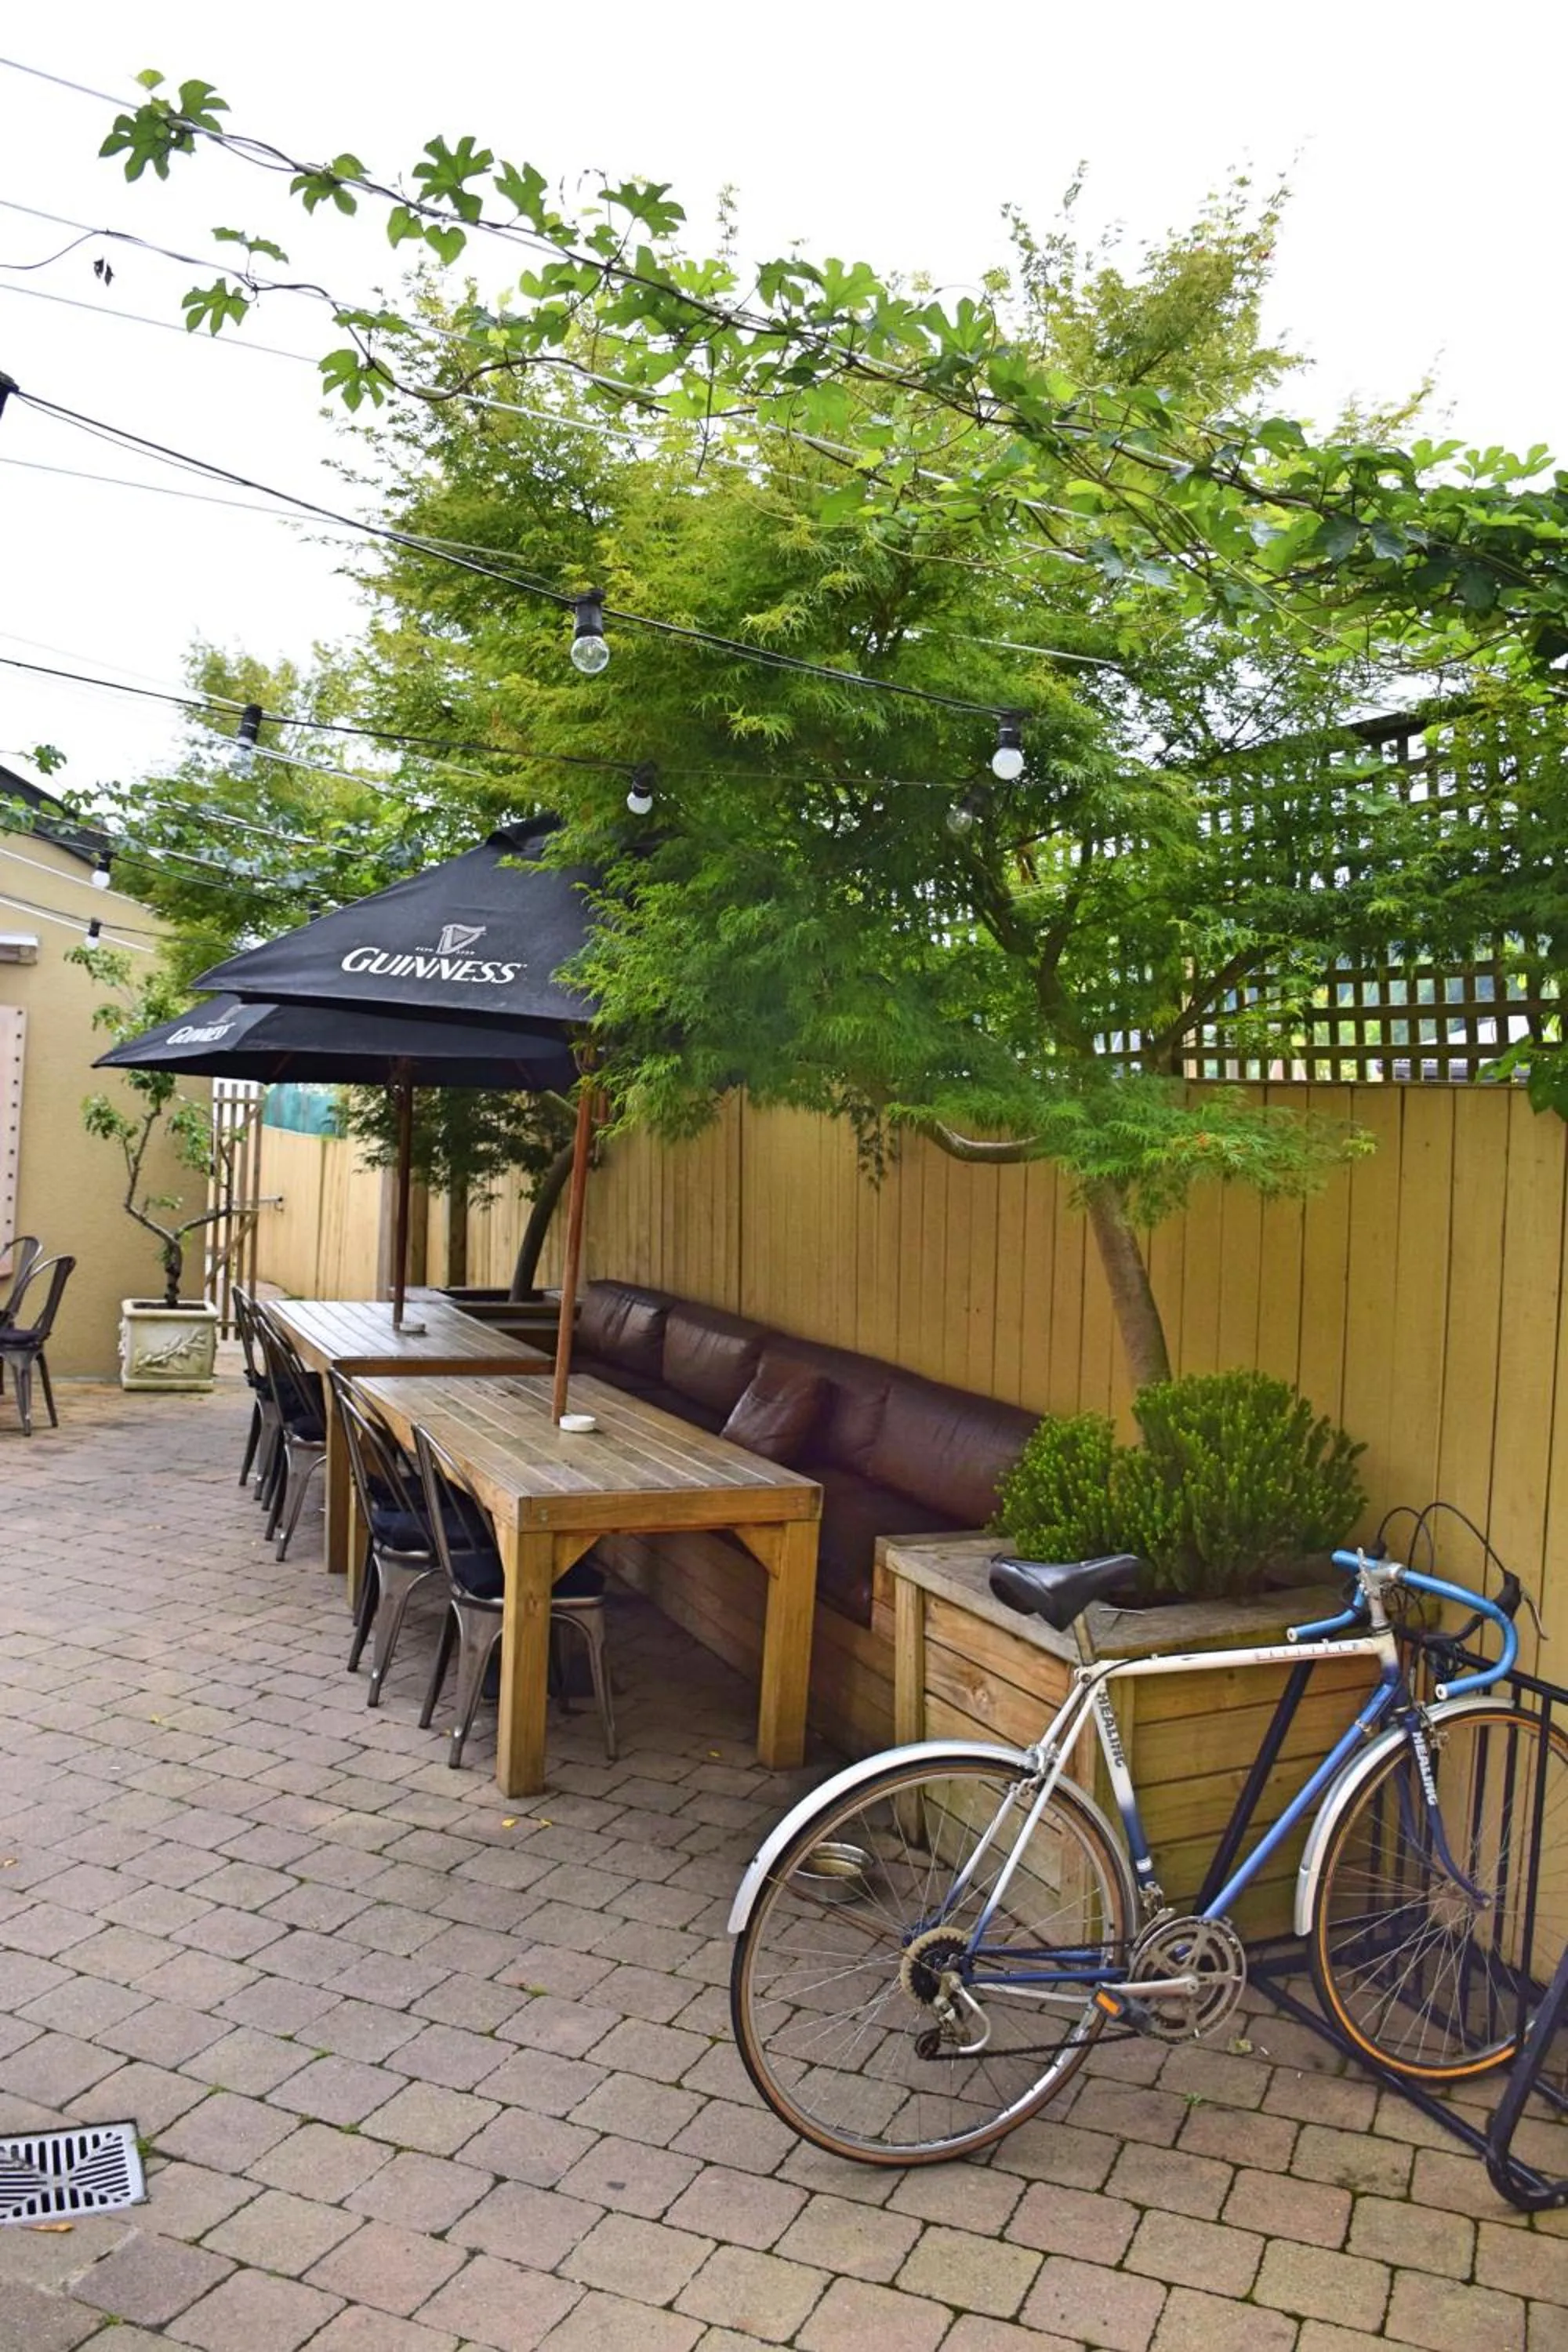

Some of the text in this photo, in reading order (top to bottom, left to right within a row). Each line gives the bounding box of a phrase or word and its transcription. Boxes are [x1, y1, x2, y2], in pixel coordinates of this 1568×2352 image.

[341, 946, 521, 985] GUINNESS
[1098, 1692, 1124, 1767] HEALING
[1412, 1731, 1438, 1806] HEALING
